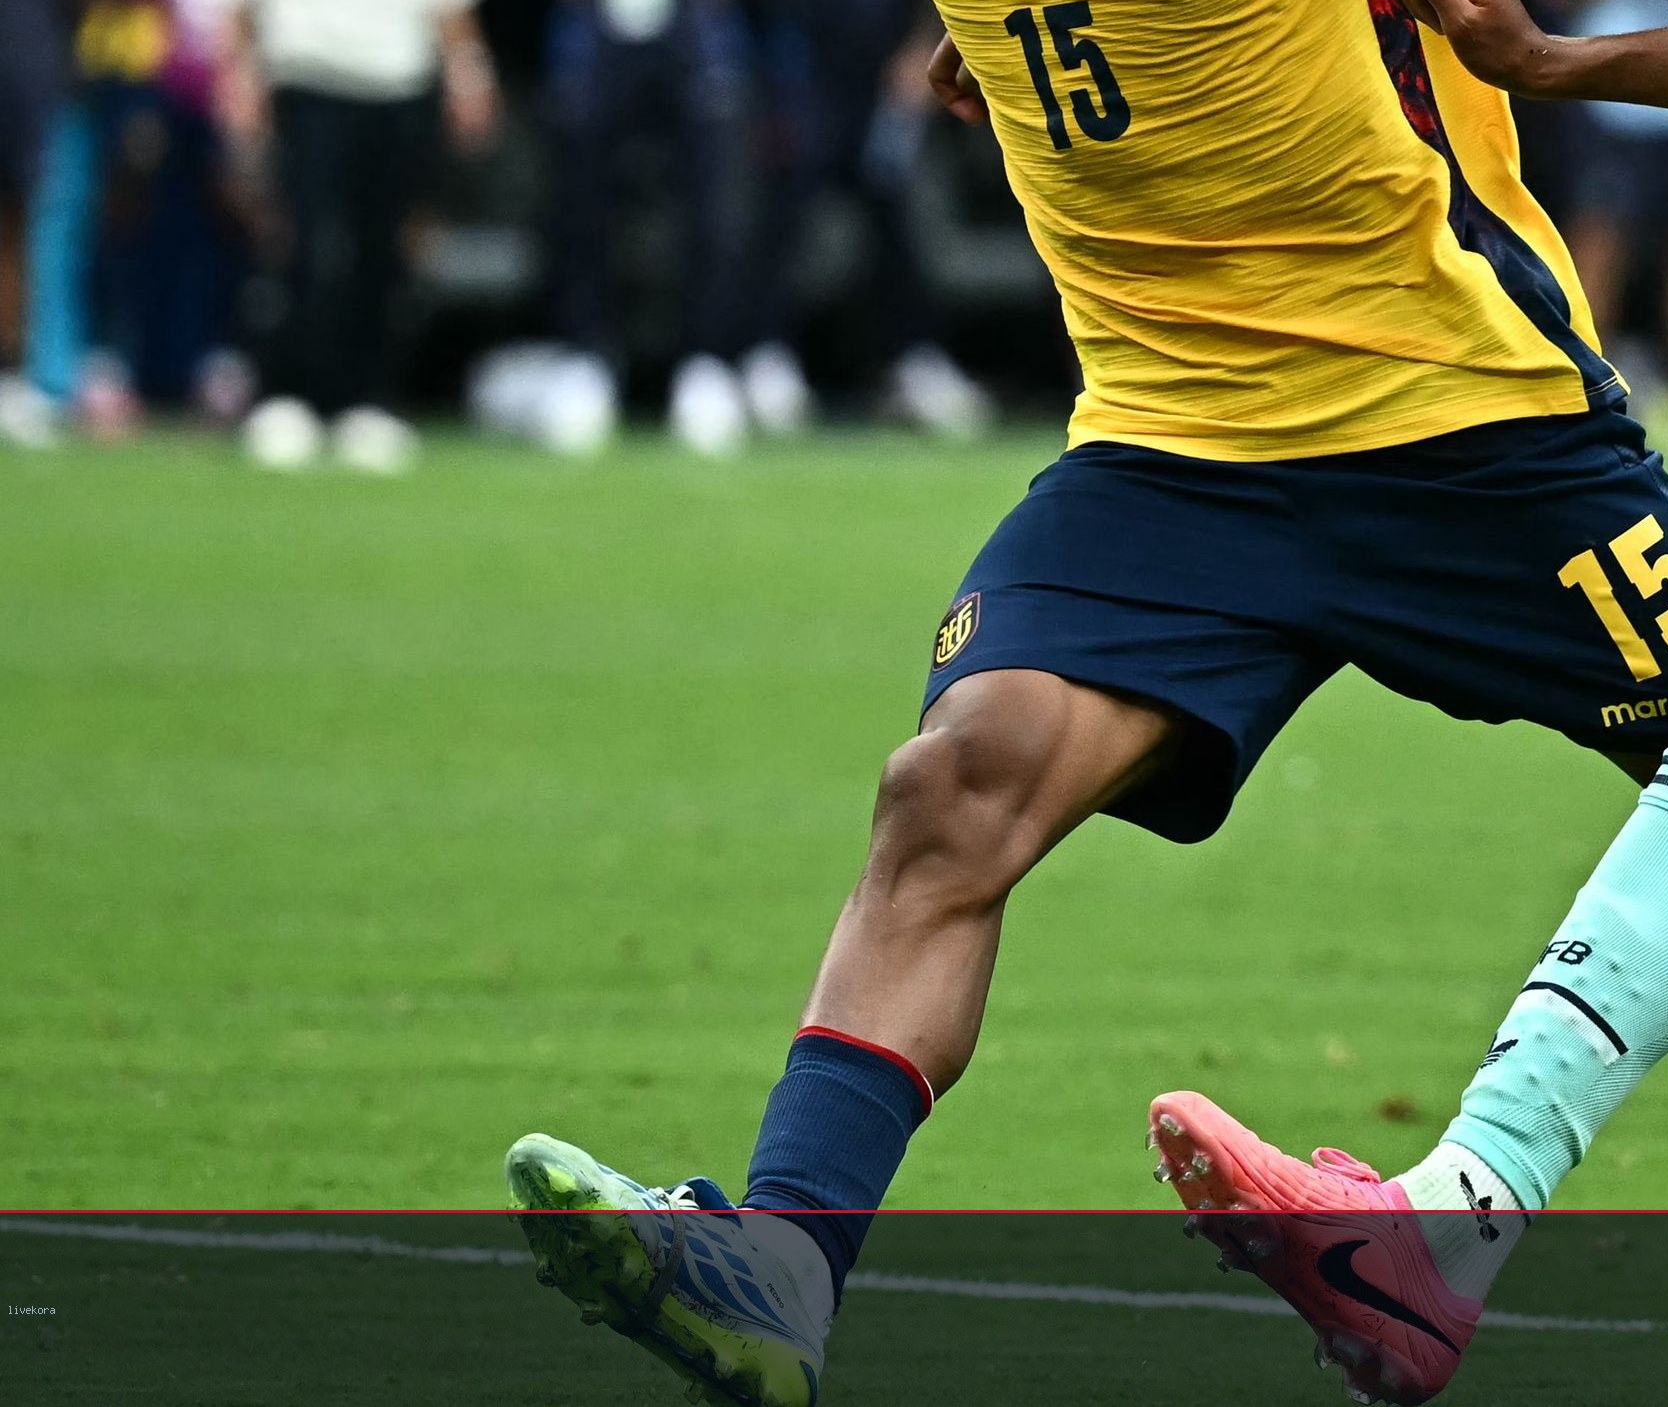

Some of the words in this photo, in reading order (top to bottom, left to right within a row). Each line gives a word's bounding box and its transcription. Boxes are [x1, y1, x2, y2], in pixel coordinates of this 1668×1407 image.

[1003, 0, 1131, 150] 15
[1539, 940, 1593, 966] FB
[767, 1282, 785, 1310] PEDRO
